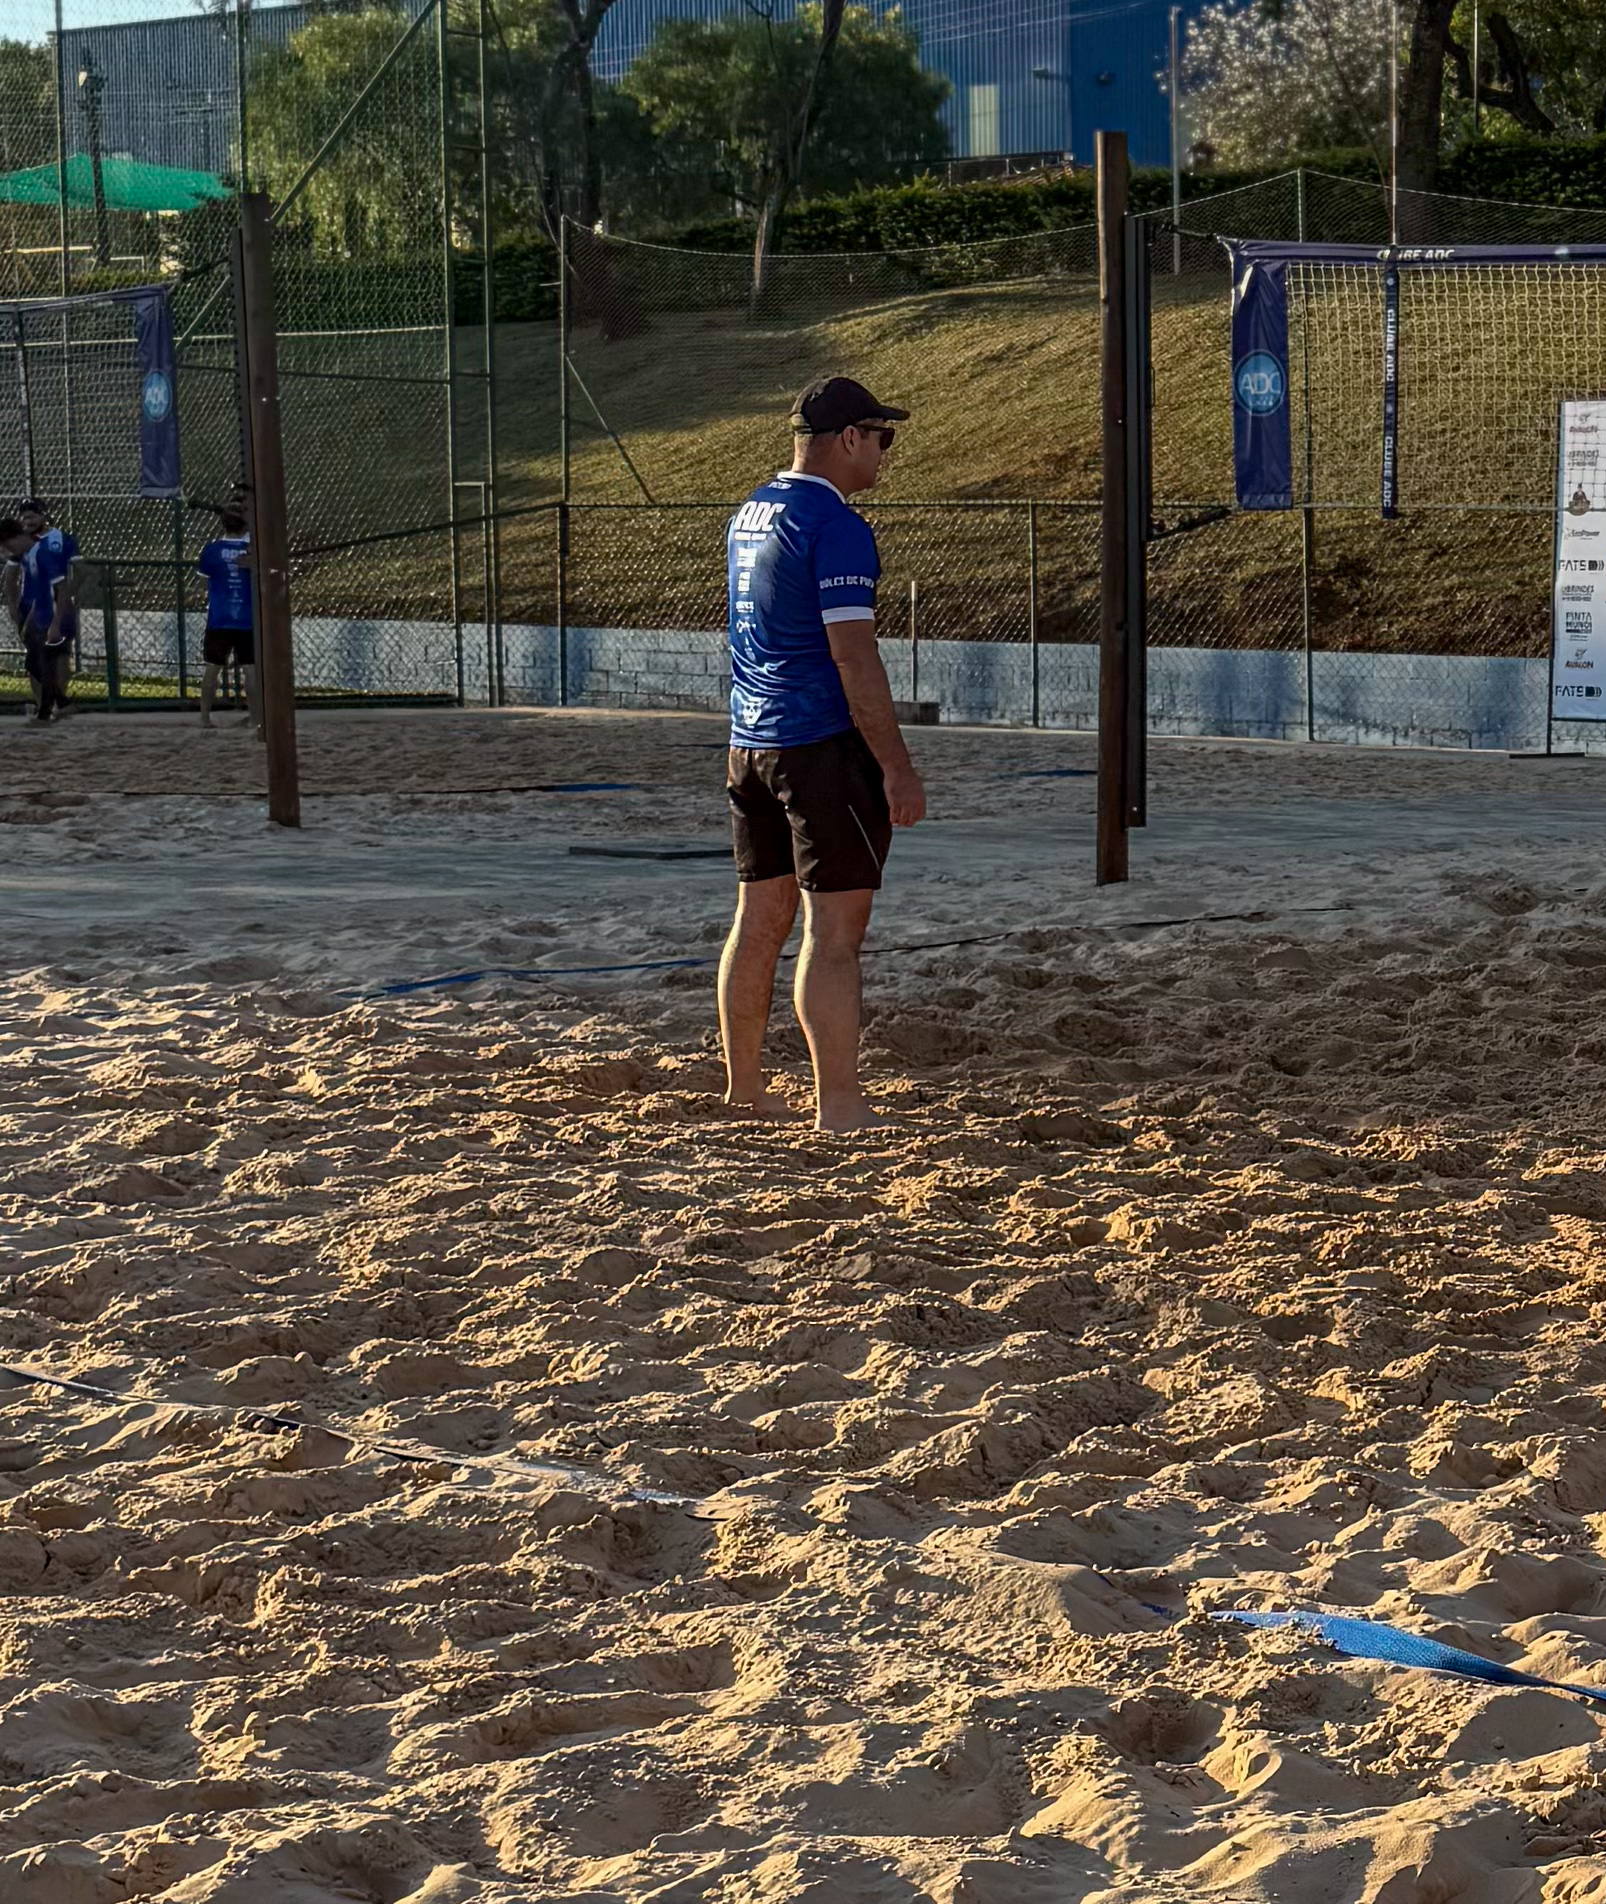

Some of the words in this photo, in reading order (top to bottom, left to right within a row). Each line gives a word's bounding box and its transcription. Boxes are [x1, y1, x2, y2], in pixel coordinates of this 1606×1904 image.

[1240, 372, 1281, 395] ADC
[1383, 481, 1392, 508] ADC
[735, 501, 786, 532] ADC
